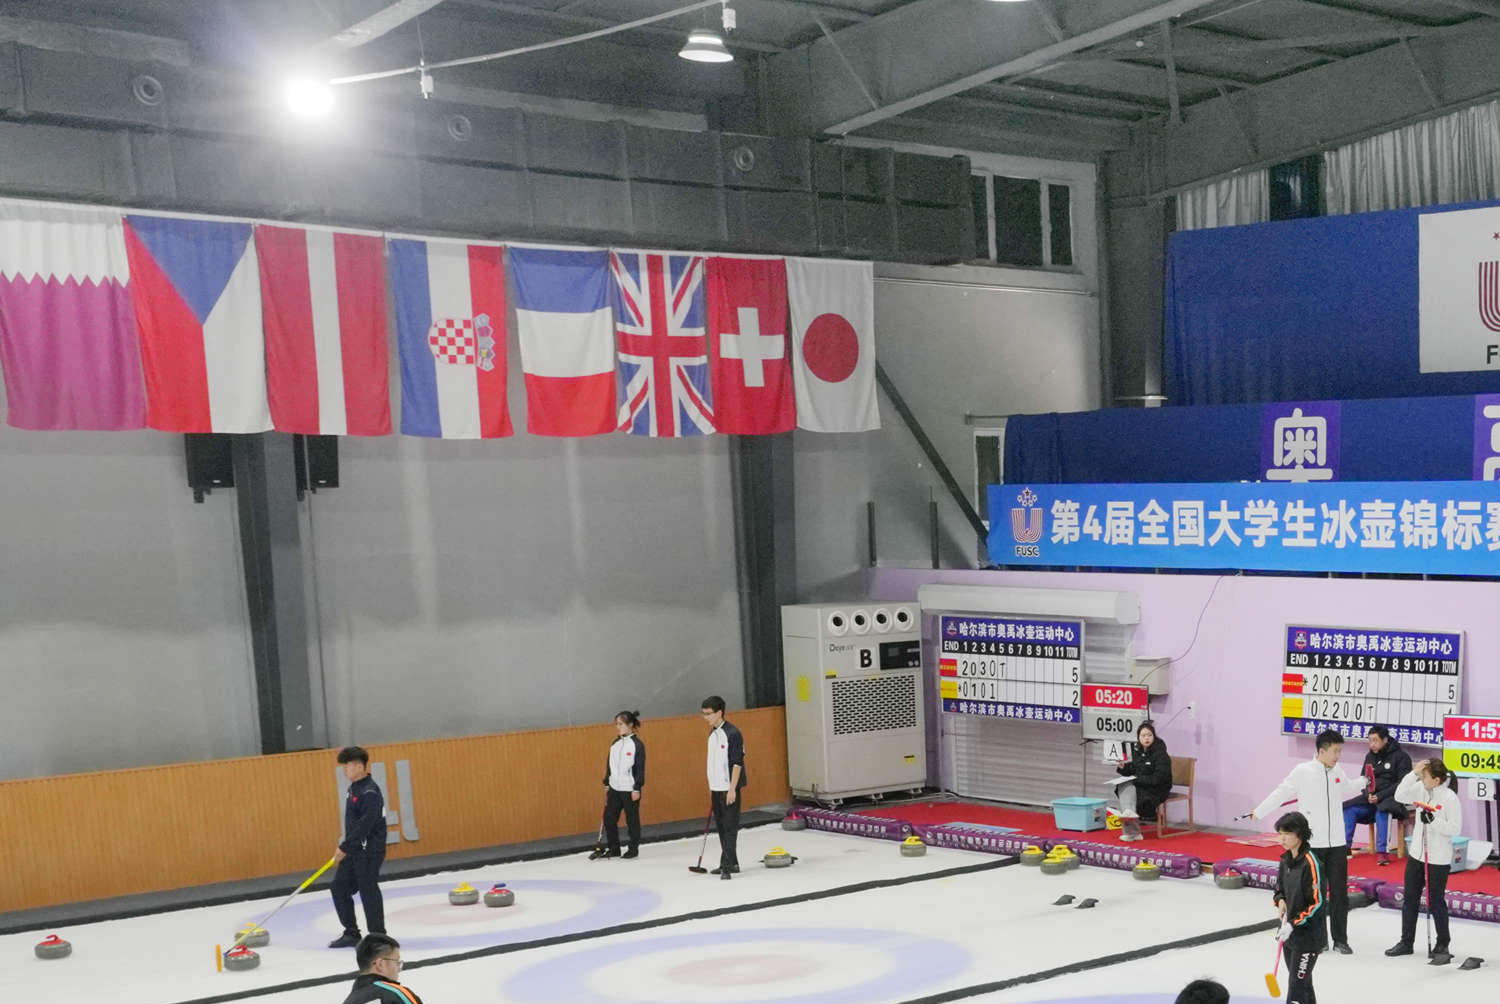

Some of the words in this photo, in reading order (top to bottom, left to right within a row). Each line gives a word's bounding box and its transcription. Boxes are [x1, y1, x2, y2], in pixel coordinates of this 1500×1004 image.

[1266, 407, 1333, 482] 奥
[1016, 546, 1040, 556] FUSC
[959, 622, 1074, 641] 哈尔滨市奥禹冰壶运动中心
[944, 641, 959, 650] END
[1310, 632, 1452, 655] 哈尔滨市奥禹冰壶运动中心
[860, 649, 872, 668] B
[1291, 654, 1308, 664] END
[962, 661, 968, 675] 2
[971, 662, 976, 676] 0
[980, 661, 986, 675] 3
[990, 660, 995, 677] 0
[1000, 663, 1005, 677] T
[1073, 667, 1078, 683] 5
[963, 681, 968, 697] 0
[972, 684, 976, 696] 1
[981, 682, 985, 698] 0
[990, 683, 995, 699] 1
[1072, 690, 1078, 706] 2
[1313, 674, 1318, 691] 2
[1323, 676, 1329, 692] 0
[1335, 676, 1340, 693] 0
[1346, 676, 1351, 694] 1
[1357, 679, 1363, 694] 2
[1449, 684, 1454, 699] 5
[1096, 689, 1133, 705] 05:20
[1311, 701, 1317, 717] 0
[1323, 700, 1328, 717] 2
[1332, 702, 1339, 718] 2
[1343, 701, 1348, 717] 0
[1355, 704, 1362, 720] 0
[1368, 706, 1373, 720] T
[1097, 717, 1132, 733] 05:00
[1110, 744, 1118, 757] A
[1478, 782, 1487, 797] B
[1297, 953, 1310, 979] CHINA
